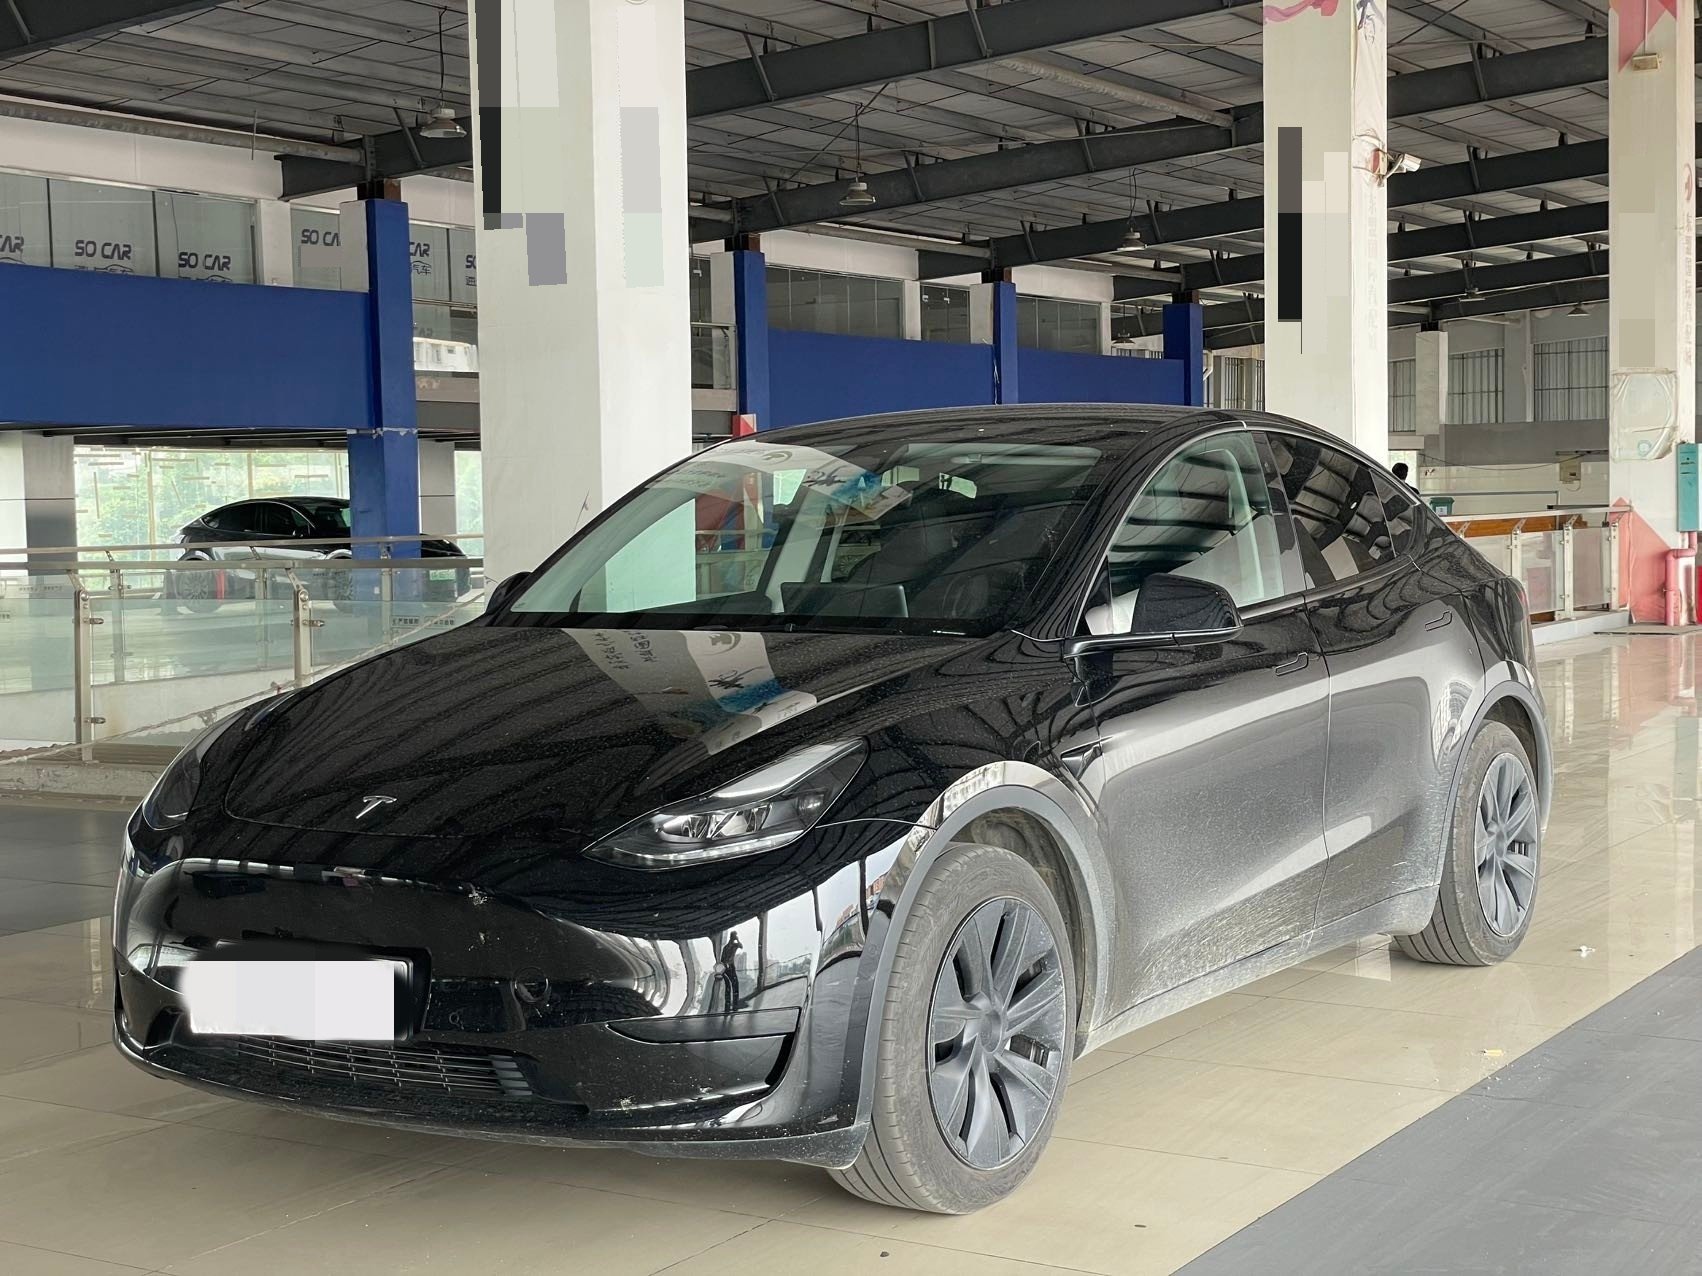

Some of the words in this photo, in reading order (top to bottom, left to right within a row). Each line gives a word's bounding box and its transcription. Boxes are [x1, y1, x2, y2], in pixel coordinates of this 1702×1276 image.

[0, 234, 25, 253] AR
[301, 228, 320, 245] SO
[323, 231, 341, 247] CA
[74, 239, 97, 258] SO
[101, 242, 132, 260] CAR
[178, 251, 199, 269] SO
[204, 254, 232, 271] CAR
